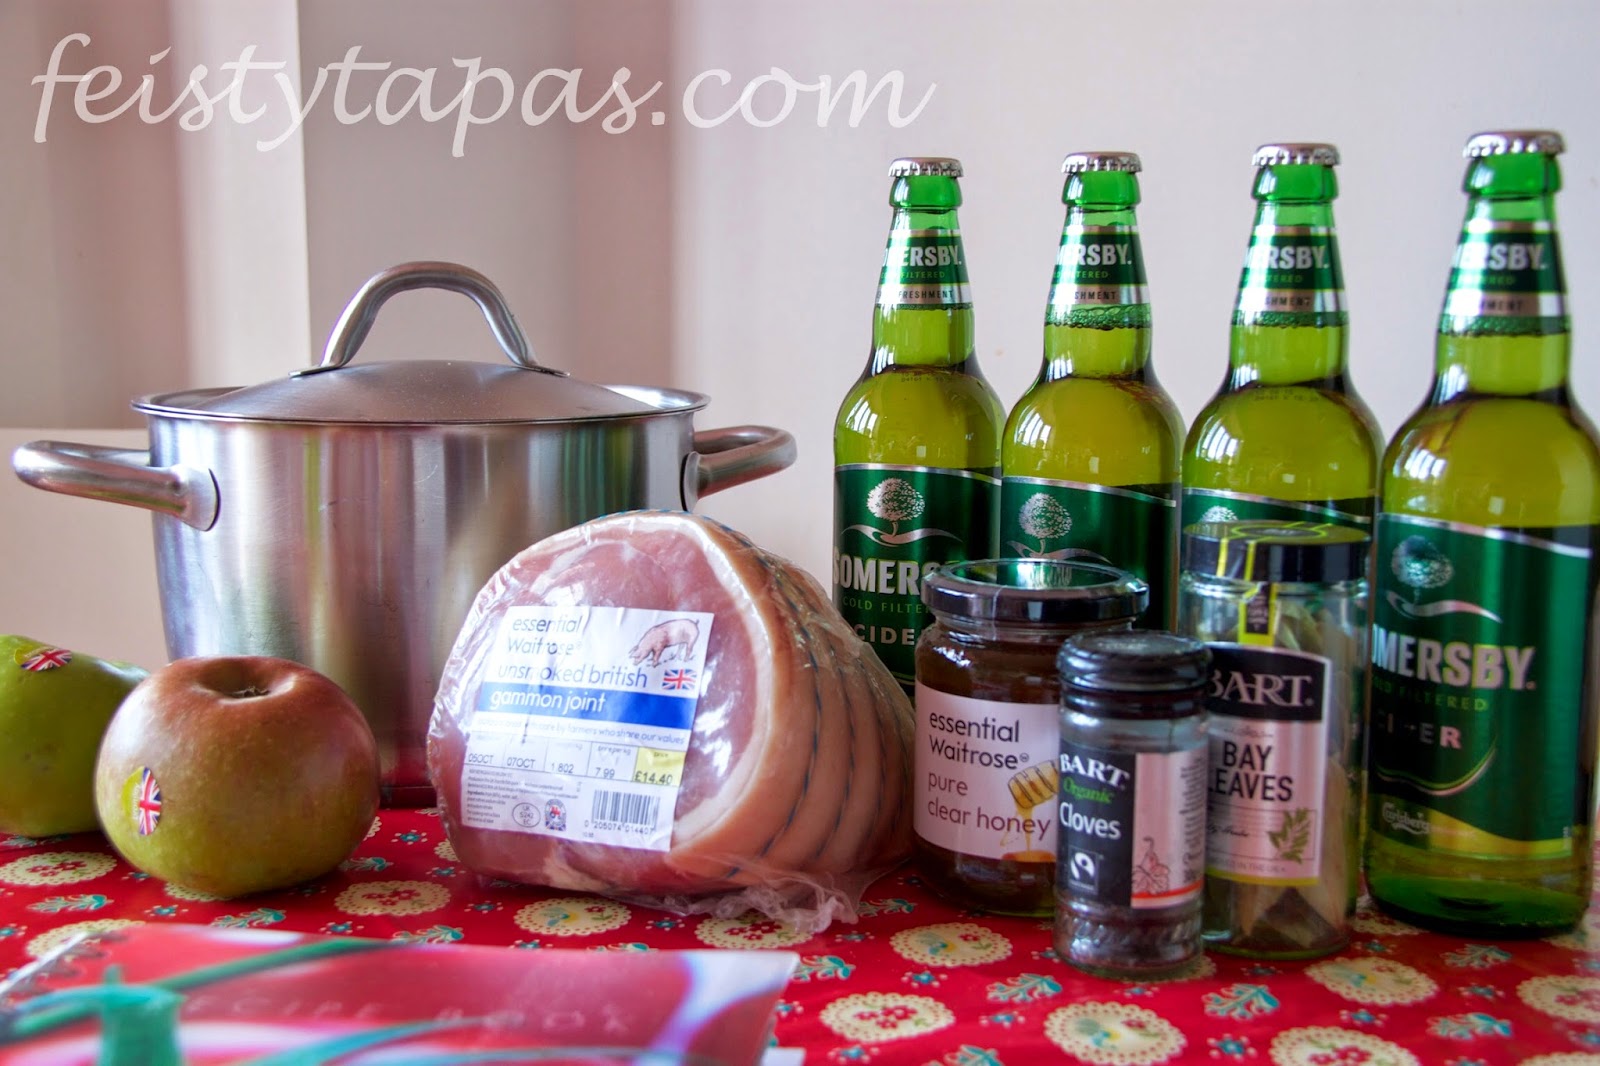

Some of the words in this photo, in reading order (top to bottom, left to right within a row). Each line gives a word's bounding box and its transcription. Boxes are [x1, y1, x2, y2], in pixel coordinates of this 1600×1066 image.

[898, 290, 953, 299] FRESHMENT
[833, 546, 941, 596] SOMER
[842, 596, 873, 611] COLD
[881, 602, 933, 614] FILTE
[512, 613, 583, 634] essential
[854, 623, 916, 646] CIDE
[1371, 623, 1536, 692] MERSBY.
[588, 664, 649, 689] british
[489, 689, 562, 711] gammon
[563, 690, 607, 715] joint
[641, 732, 657, 742] our
[657, 733, 685, 746] values
[929, 711, 1020, 744] essential
[506, 756, 537, 769] 07OCT
[928, 733, 1020, 771] Waitrose
[1223, 740, 1272, 772] BAY
[634, 770, 674, 786] £14.40
[927, 770, 968, 797] pure
[1059, 753, 1131, 788] BART
[1208, 767, 1295, 802] EAVES
[927, 797, 971, 825] clear
[976, 810, 1051, 842] honey
[1059, 801, 1122, 840] Cloves
